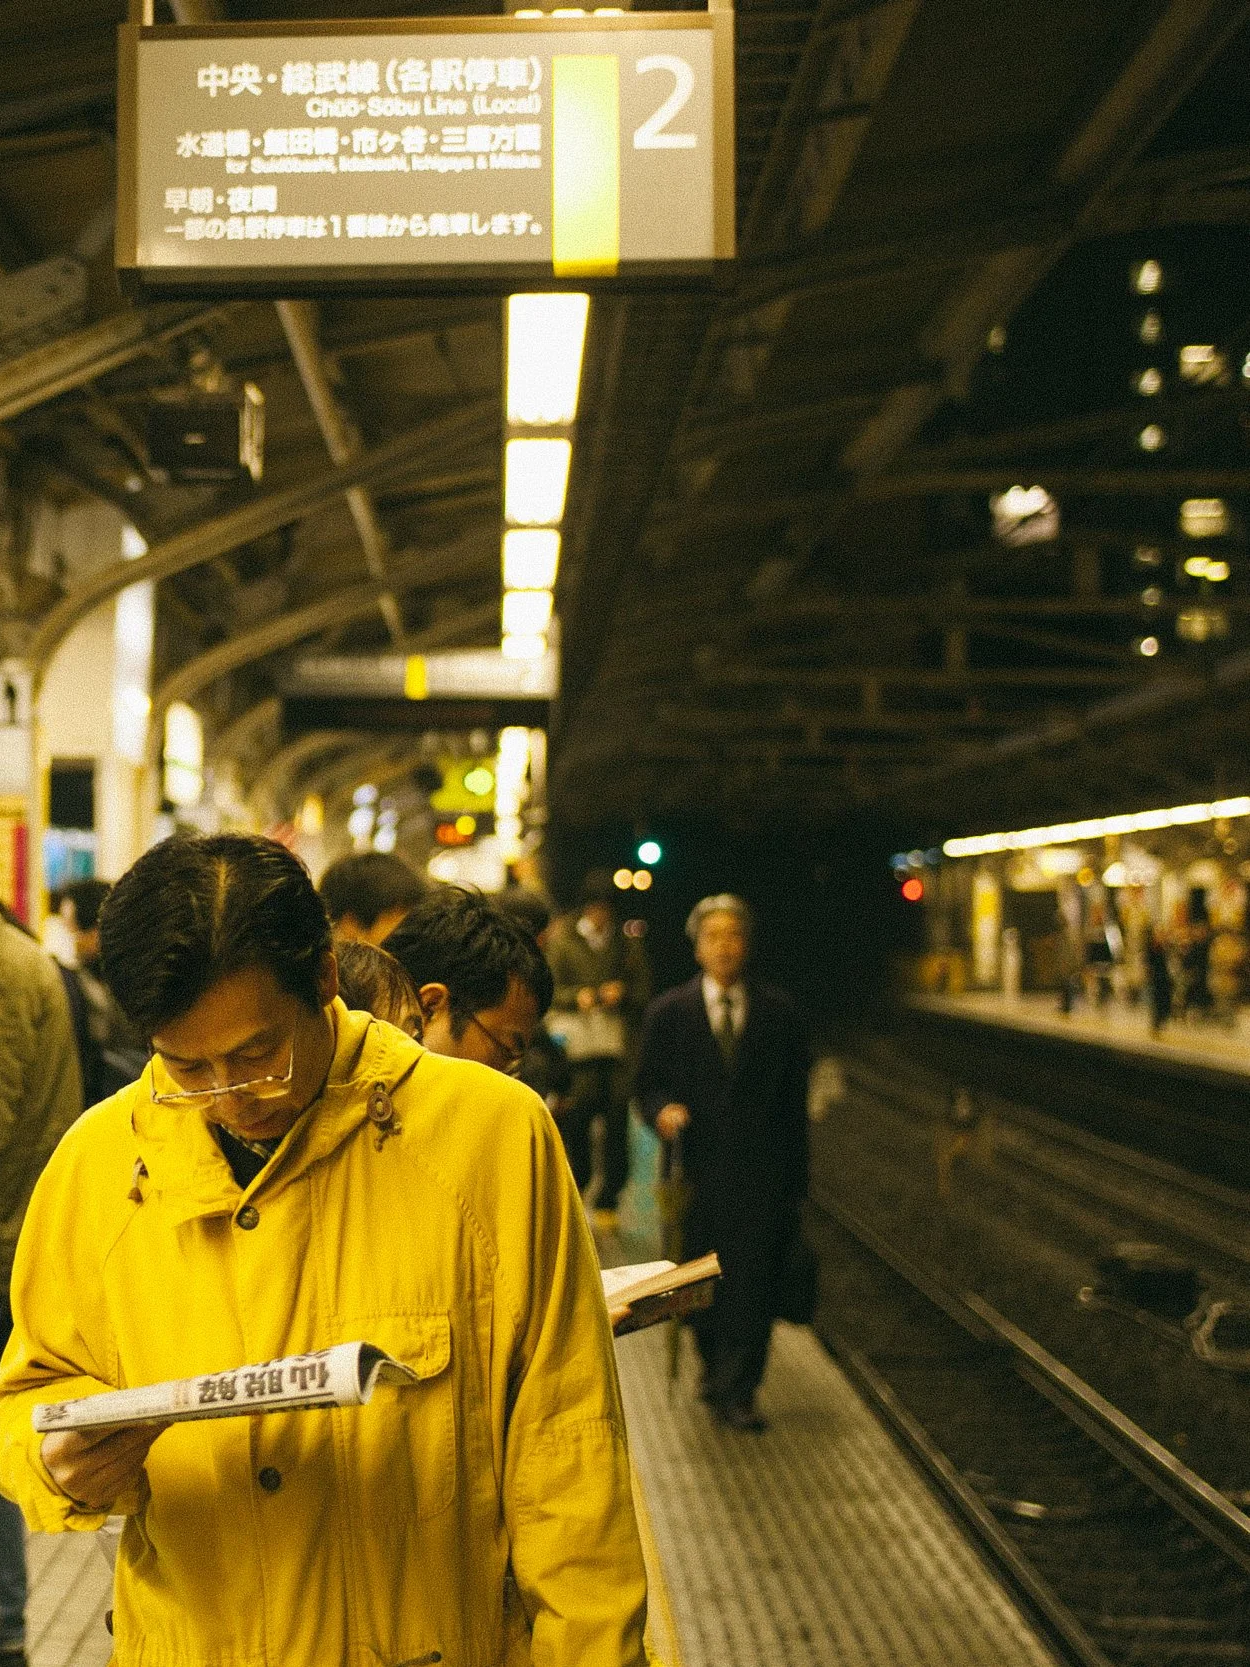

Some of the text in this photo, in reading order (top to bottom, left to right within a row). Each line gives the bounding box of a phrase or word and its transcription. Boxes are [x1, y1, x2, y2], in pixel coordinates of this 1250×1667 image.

[424, 95, 468, 116] Line
[472, 92, 542, 116] (Local)
[633, 54, 697, 149] 2
